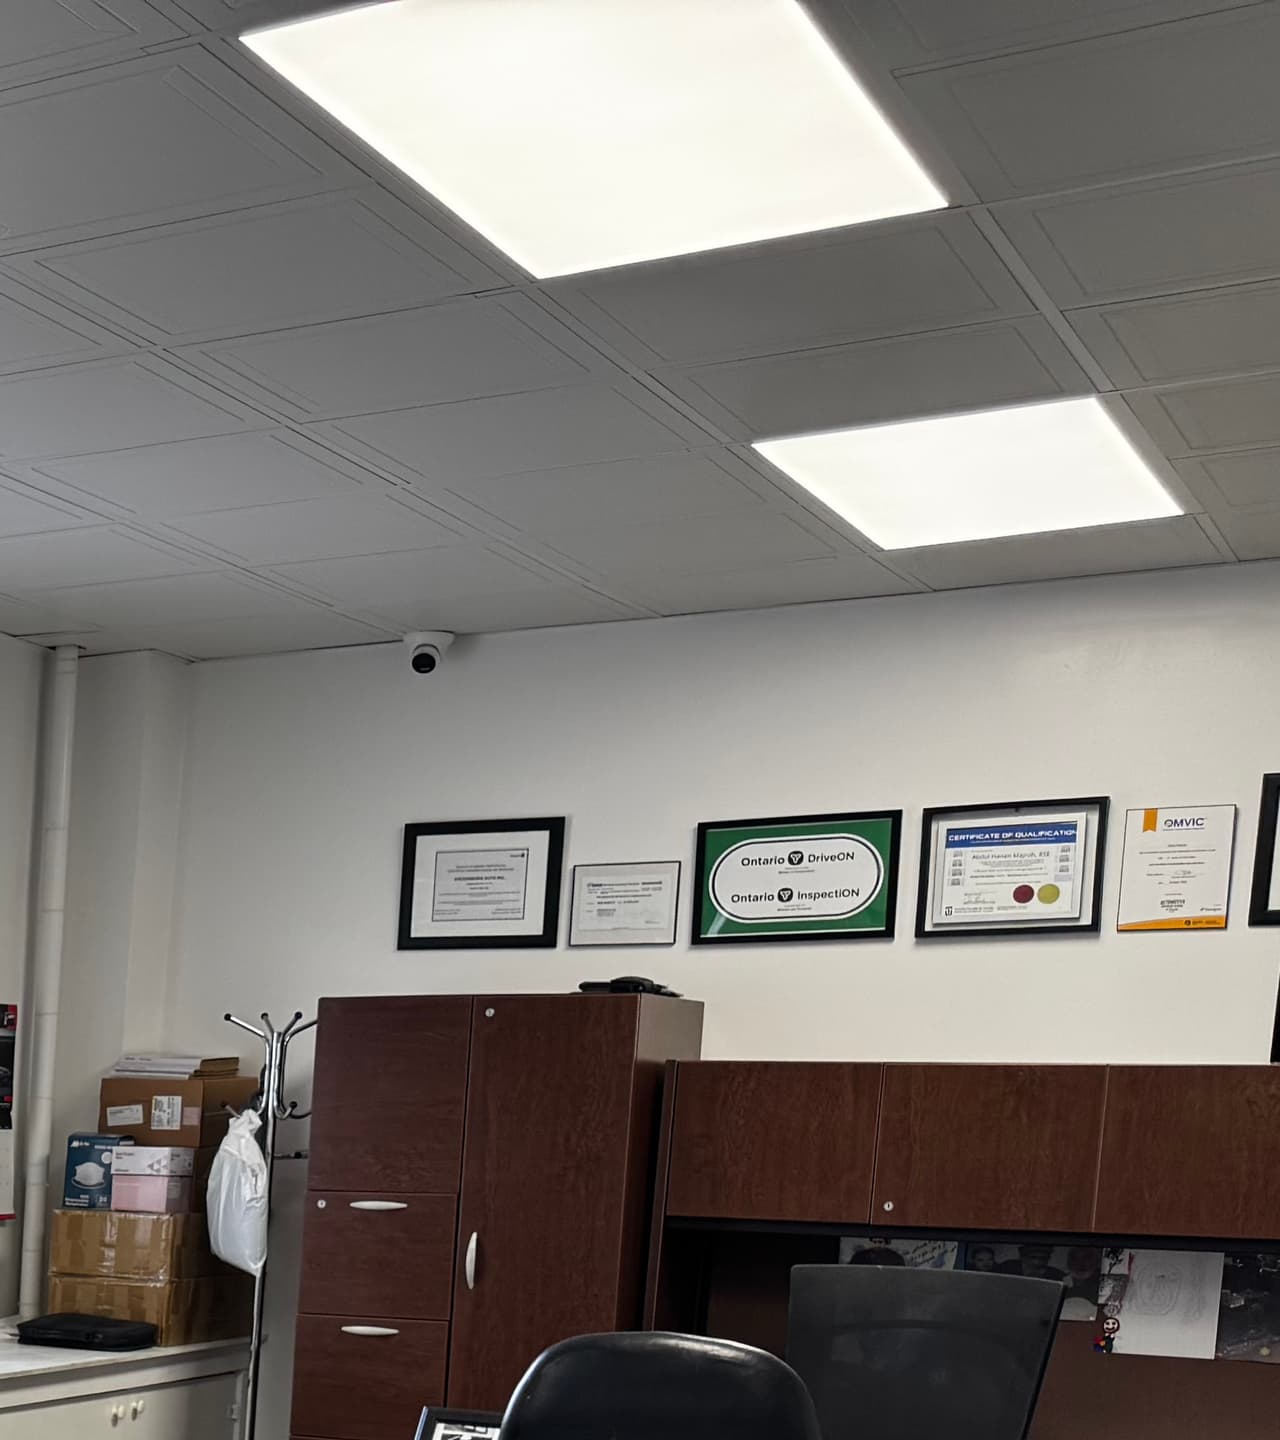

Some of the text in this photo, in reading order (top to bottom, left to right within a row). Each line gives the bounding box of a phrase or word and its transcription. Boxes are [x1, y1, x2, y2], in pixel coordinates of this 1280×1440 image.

[1163, 817, 1205, 828] OMVIC
[948, 831, 1000, 842] CERTIFICATE
[1002, 831, 1014, 840] OF
[741, 852, 855, 867] Ontario DriveON
[731, 888, 860, 904] Ontario InspectiON
